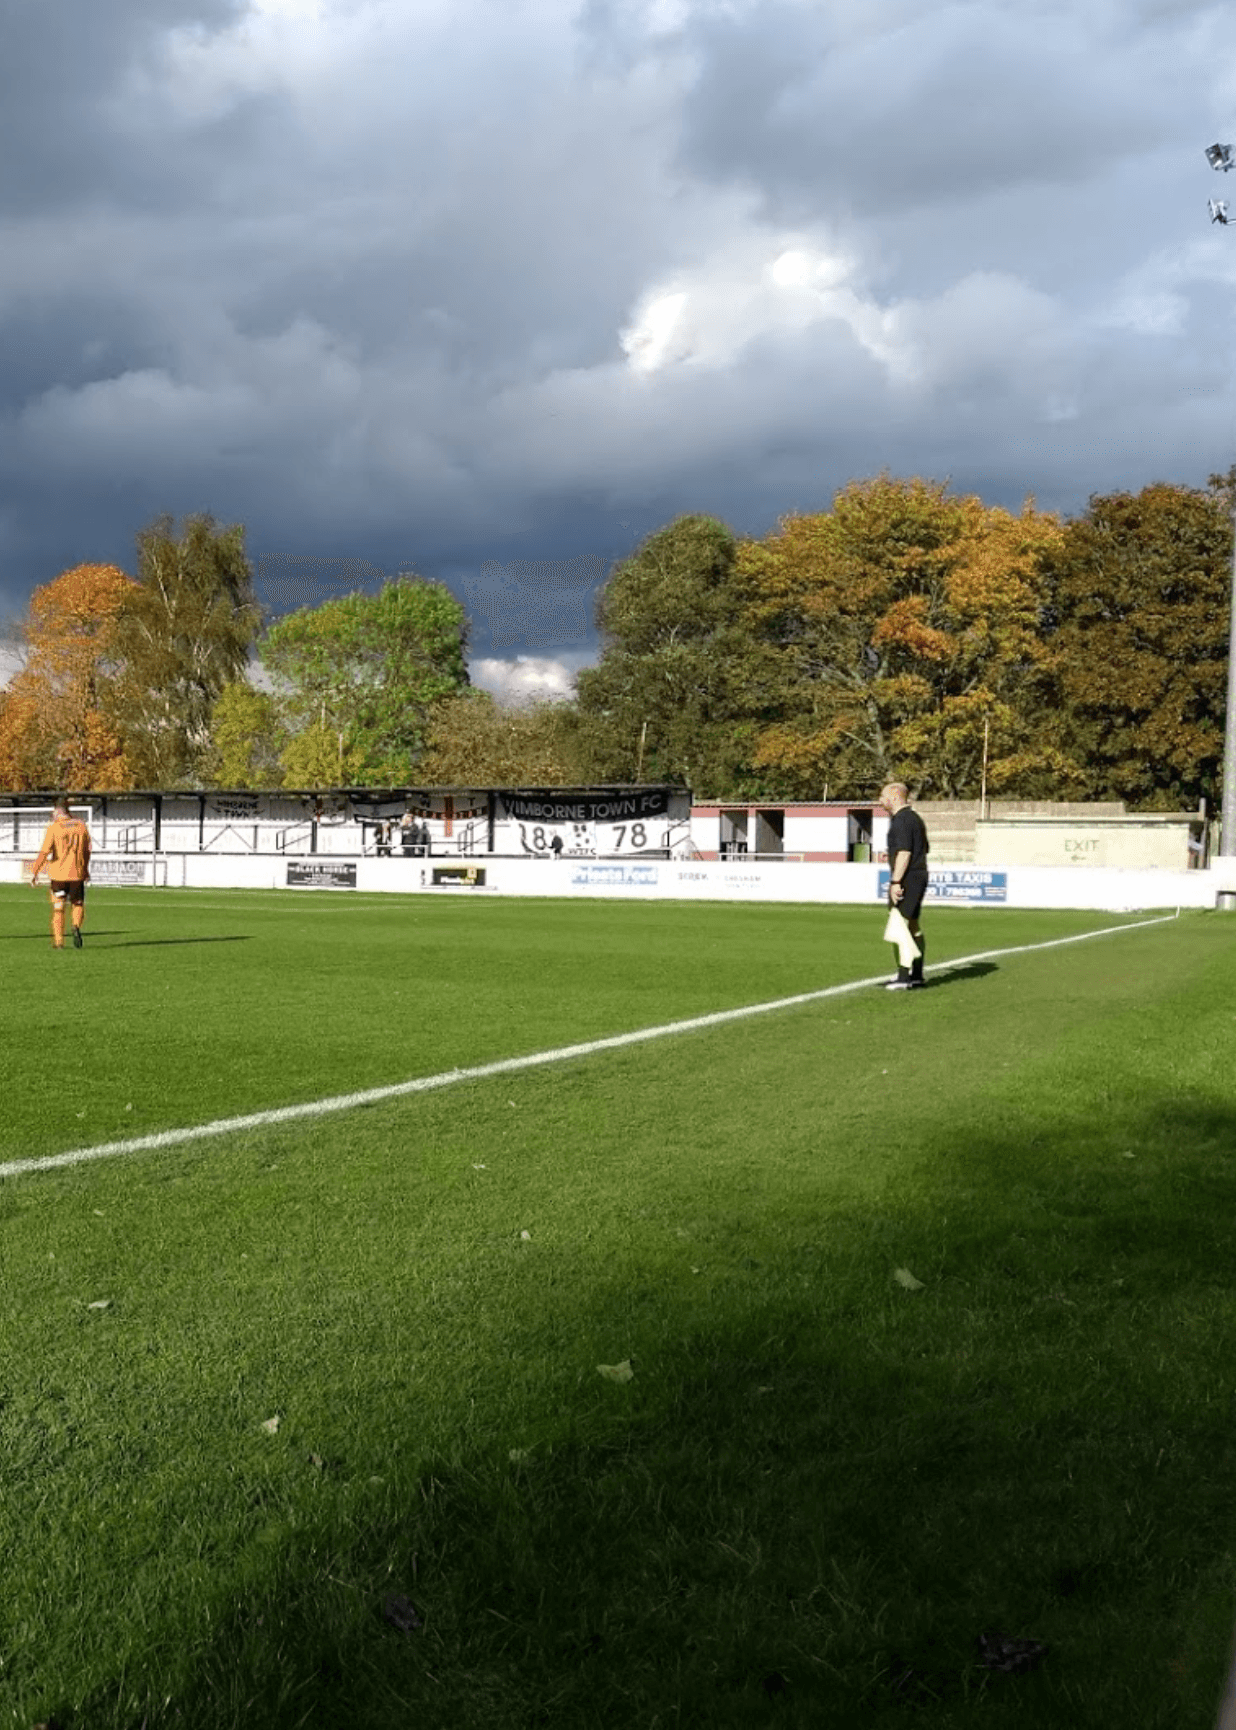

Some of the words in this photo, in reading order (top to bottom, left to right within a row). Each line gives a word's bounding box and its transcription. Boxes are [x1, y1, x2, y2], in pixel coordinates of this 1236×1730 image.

[589, 798, 636, 818] TOWN
[640, 794, 662, 812] FC
[612, 822, 647, 848] 78
[1064, 839, 1100, 852] EXIT
[956, 872, 992, 884] TAXIS
